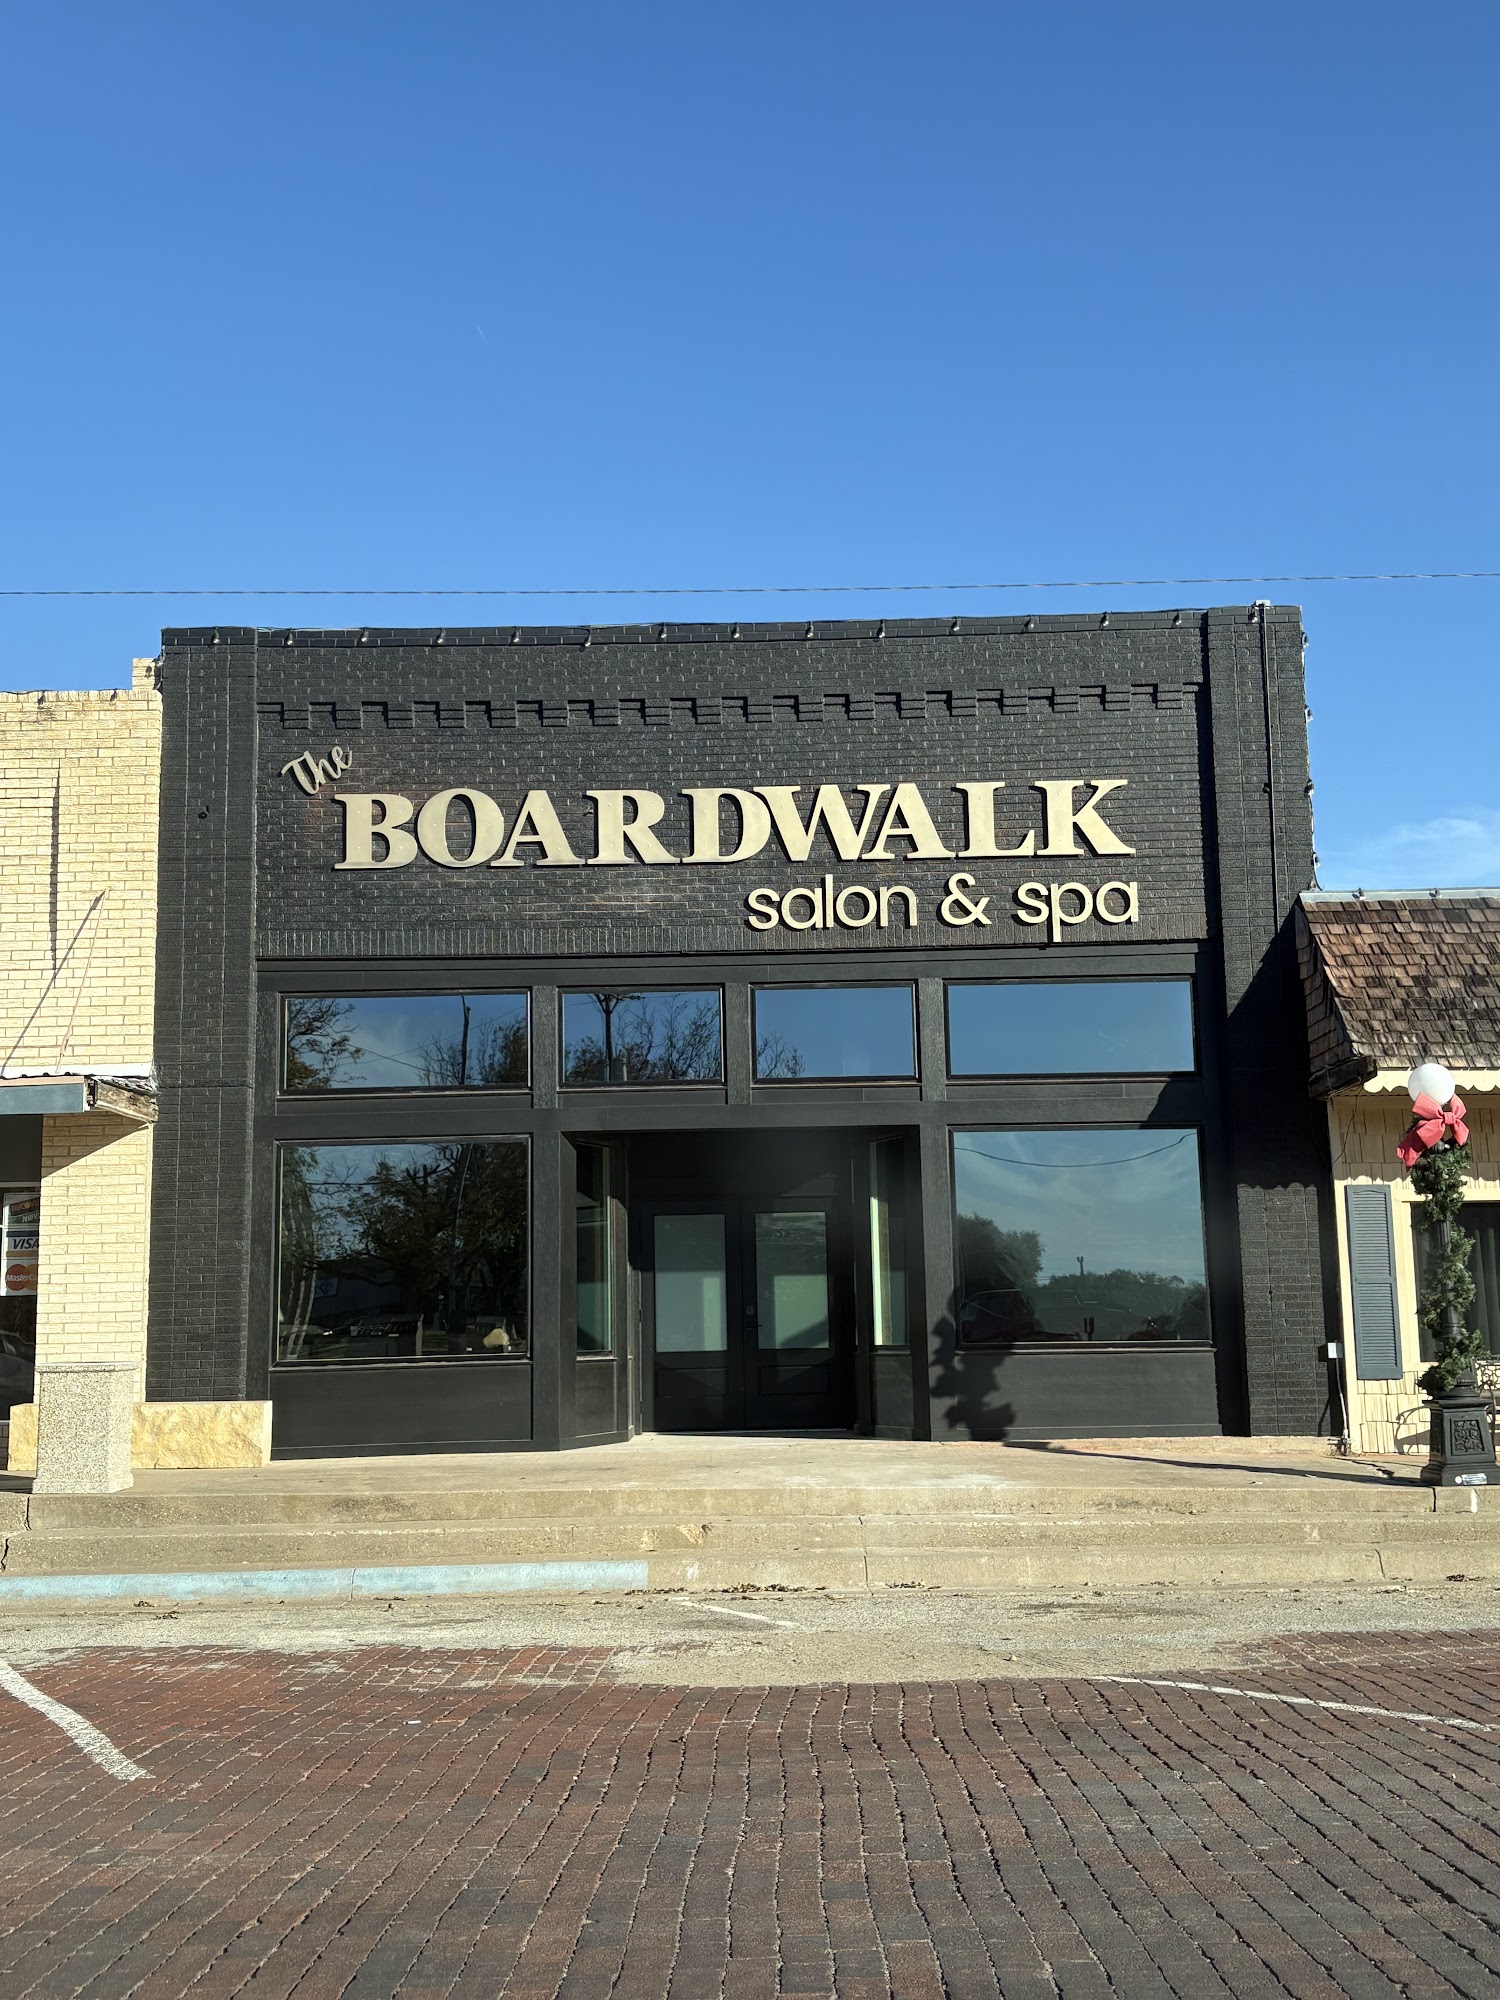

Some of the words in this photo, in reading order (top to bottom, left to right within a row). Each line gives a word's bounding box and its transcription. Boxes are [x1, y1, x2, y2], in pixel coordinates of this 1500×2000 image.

[281, 746, 354, 795] The
[334, 777, 1137, 869] BOARDWALK
[748, 873, 919, 930] salon
[941, 872, 993, 926] &
[1016, 881, 1140, 943] spa
[13, 1238, 39, 1250] VISA
